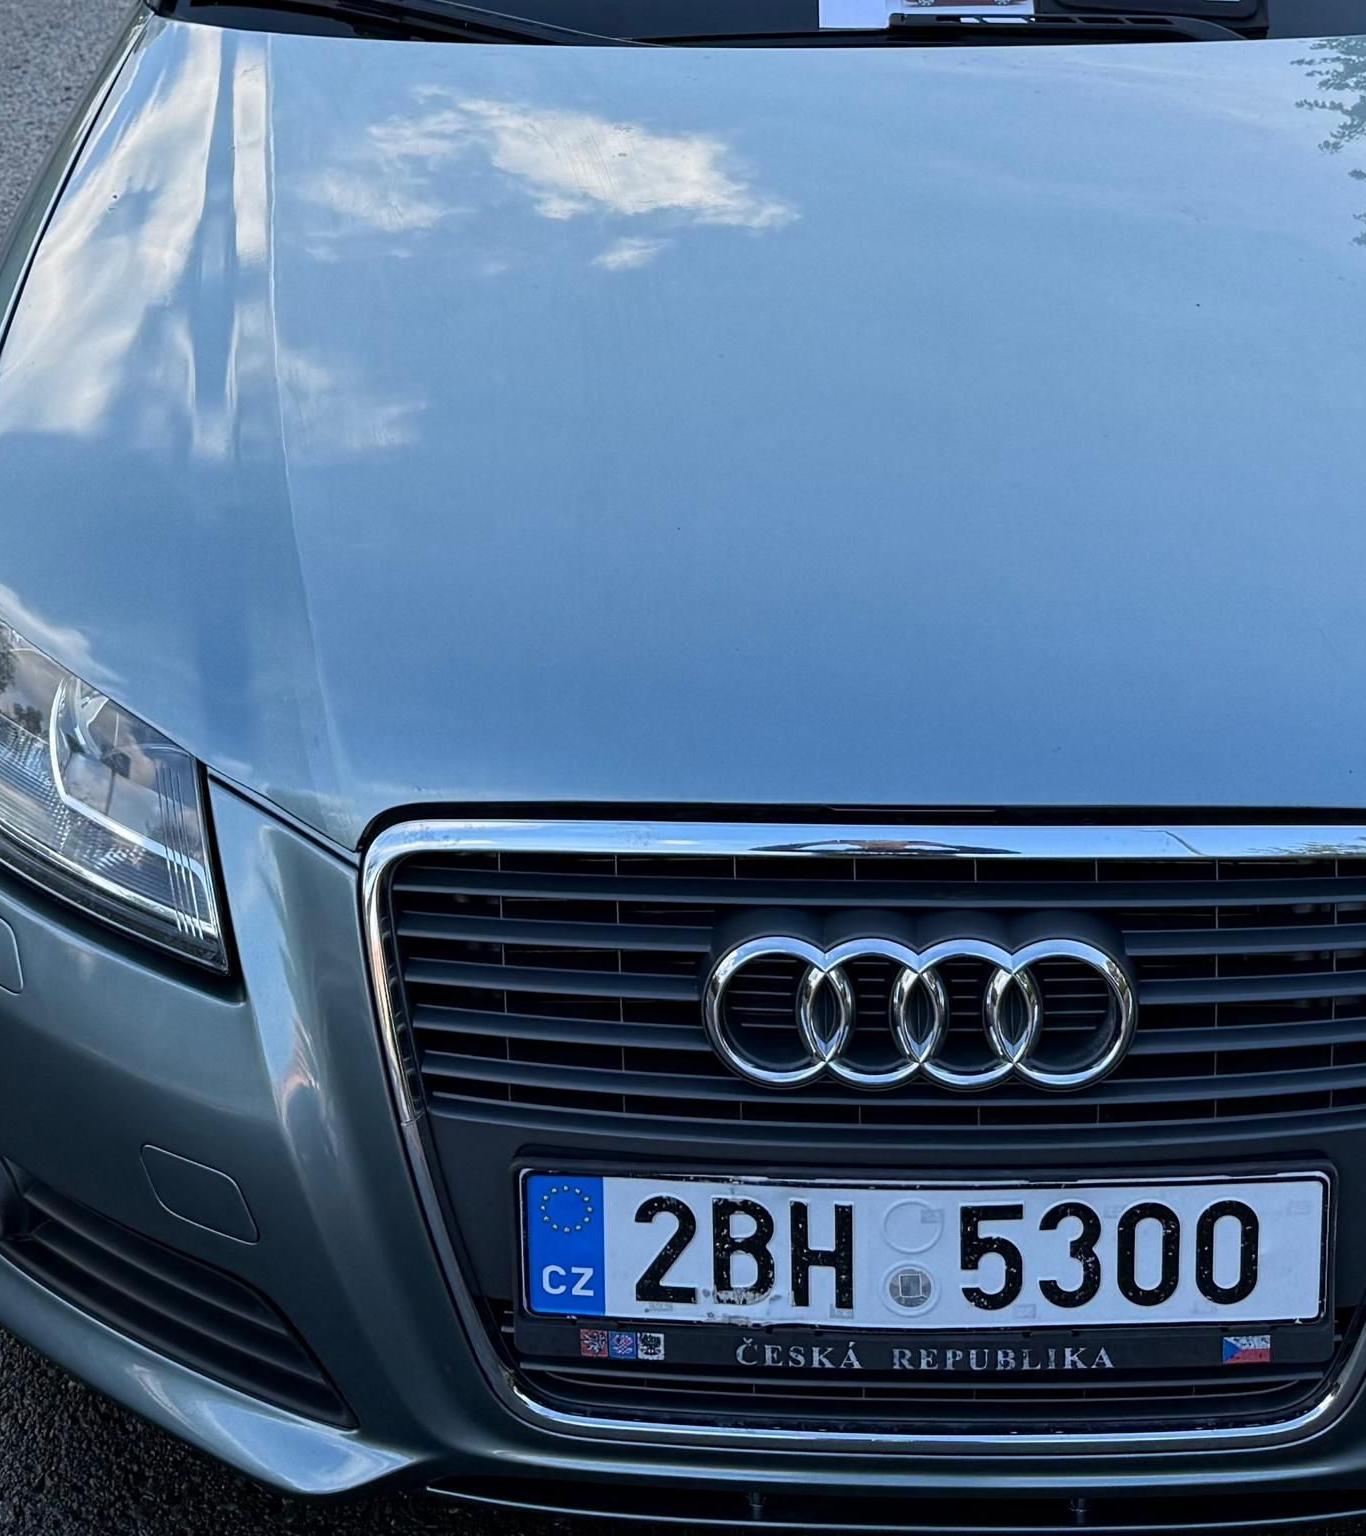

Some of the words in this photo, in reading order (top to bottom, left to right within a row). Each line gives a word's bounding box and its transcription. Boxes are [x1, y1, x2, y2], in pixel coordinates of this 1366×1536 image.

[634, 1195, 854, 1310] 2BH
[959, 1199, 1260, 1311] 5300
[541, 1264, 595, 1297] CZ
[735, 1337, 864, 1370] ČESKÁ
[891, 1346, 1116, 1371] REPUBLIKA
